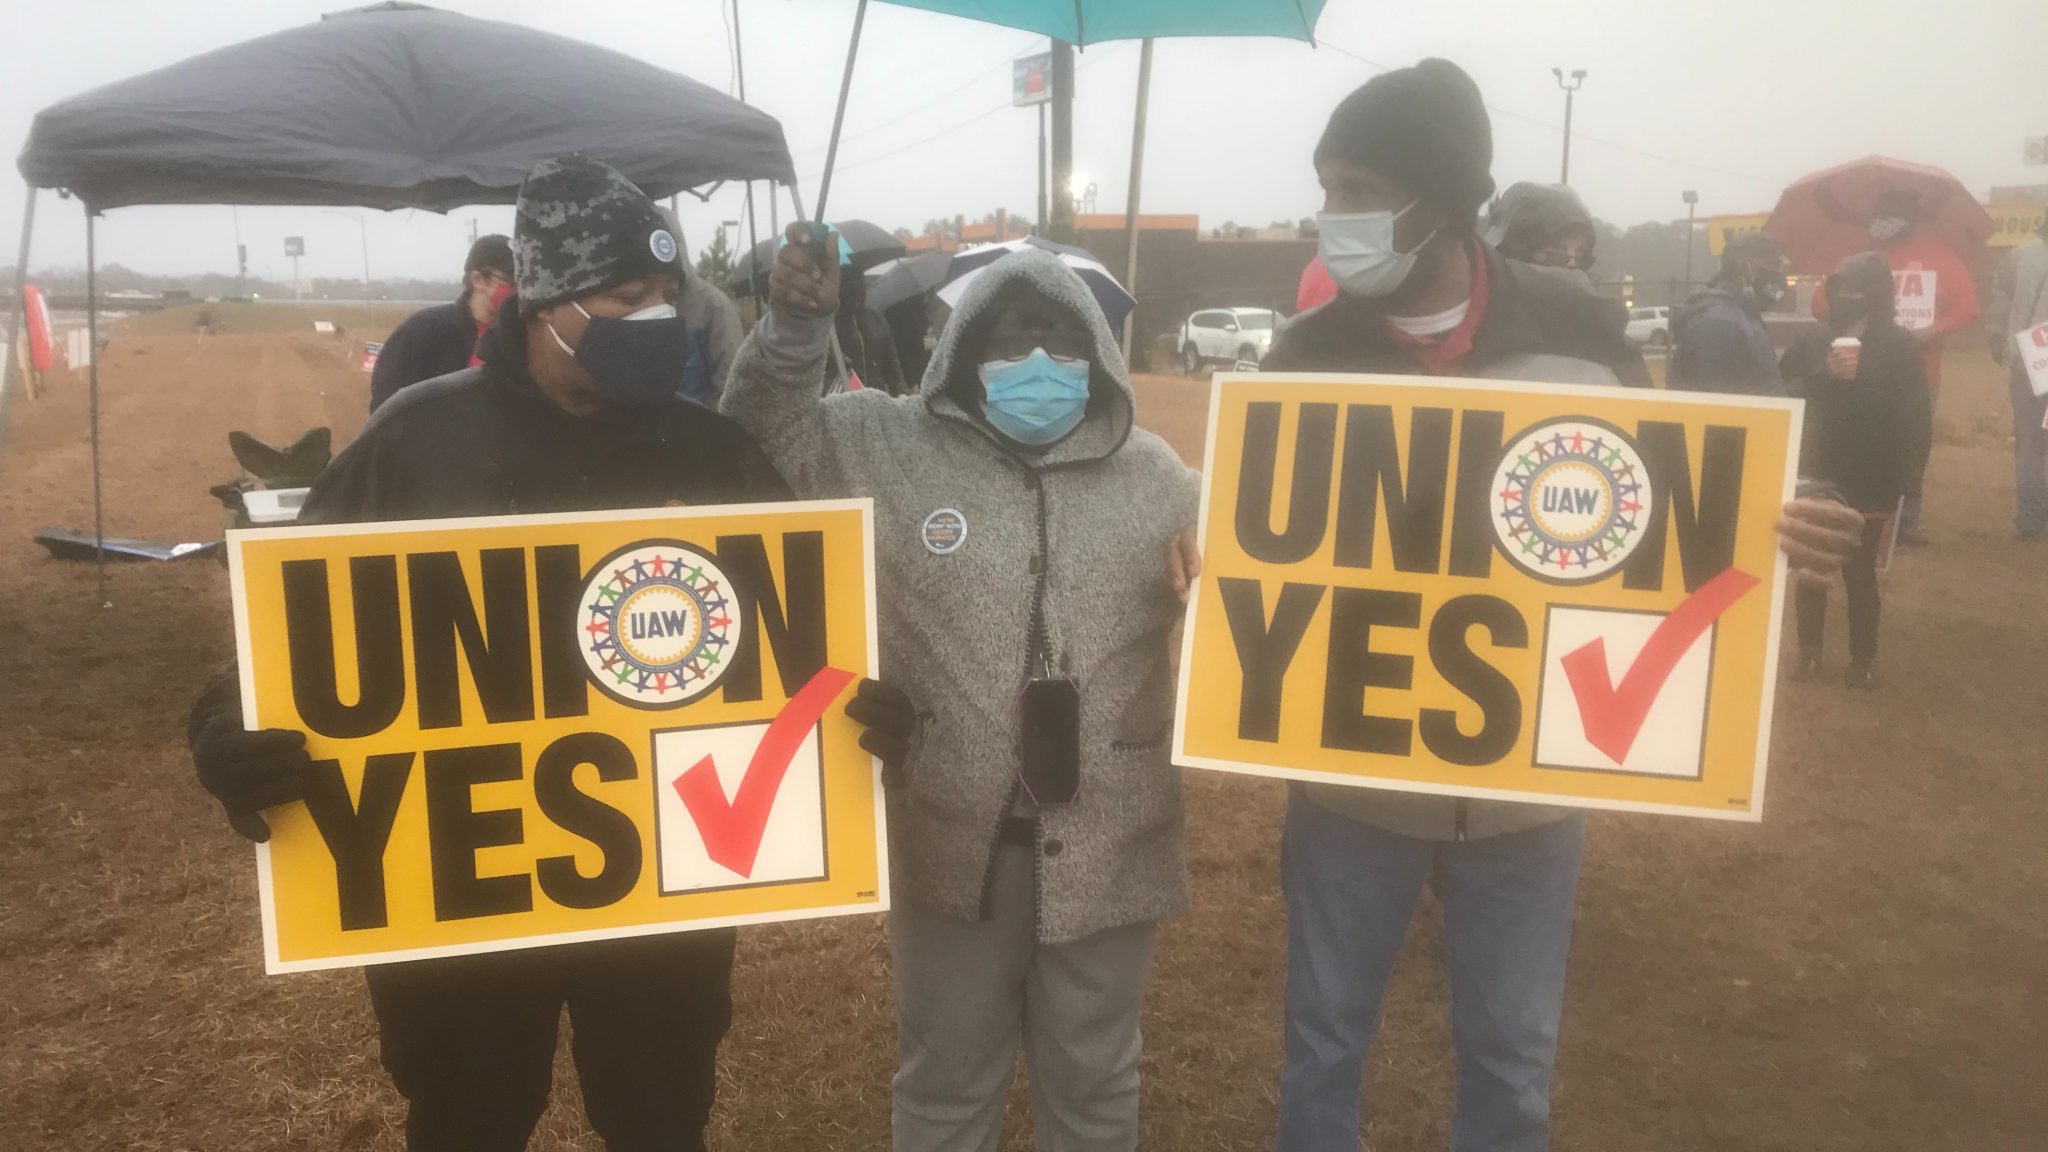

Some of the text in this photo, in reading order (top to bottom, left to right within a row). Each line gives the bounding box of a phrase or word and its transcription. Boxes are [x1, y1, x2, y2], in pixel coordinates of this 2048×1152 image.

[1234, 402, 1747, 594] UNION
[1543, 486, 1599, 515] UAW
[282, 531, 828, 739] UNION
[631, 610, 687, 639] UAW
[1217, 577, 1529, 767] YES
[303, 732, 643, 932] YES
